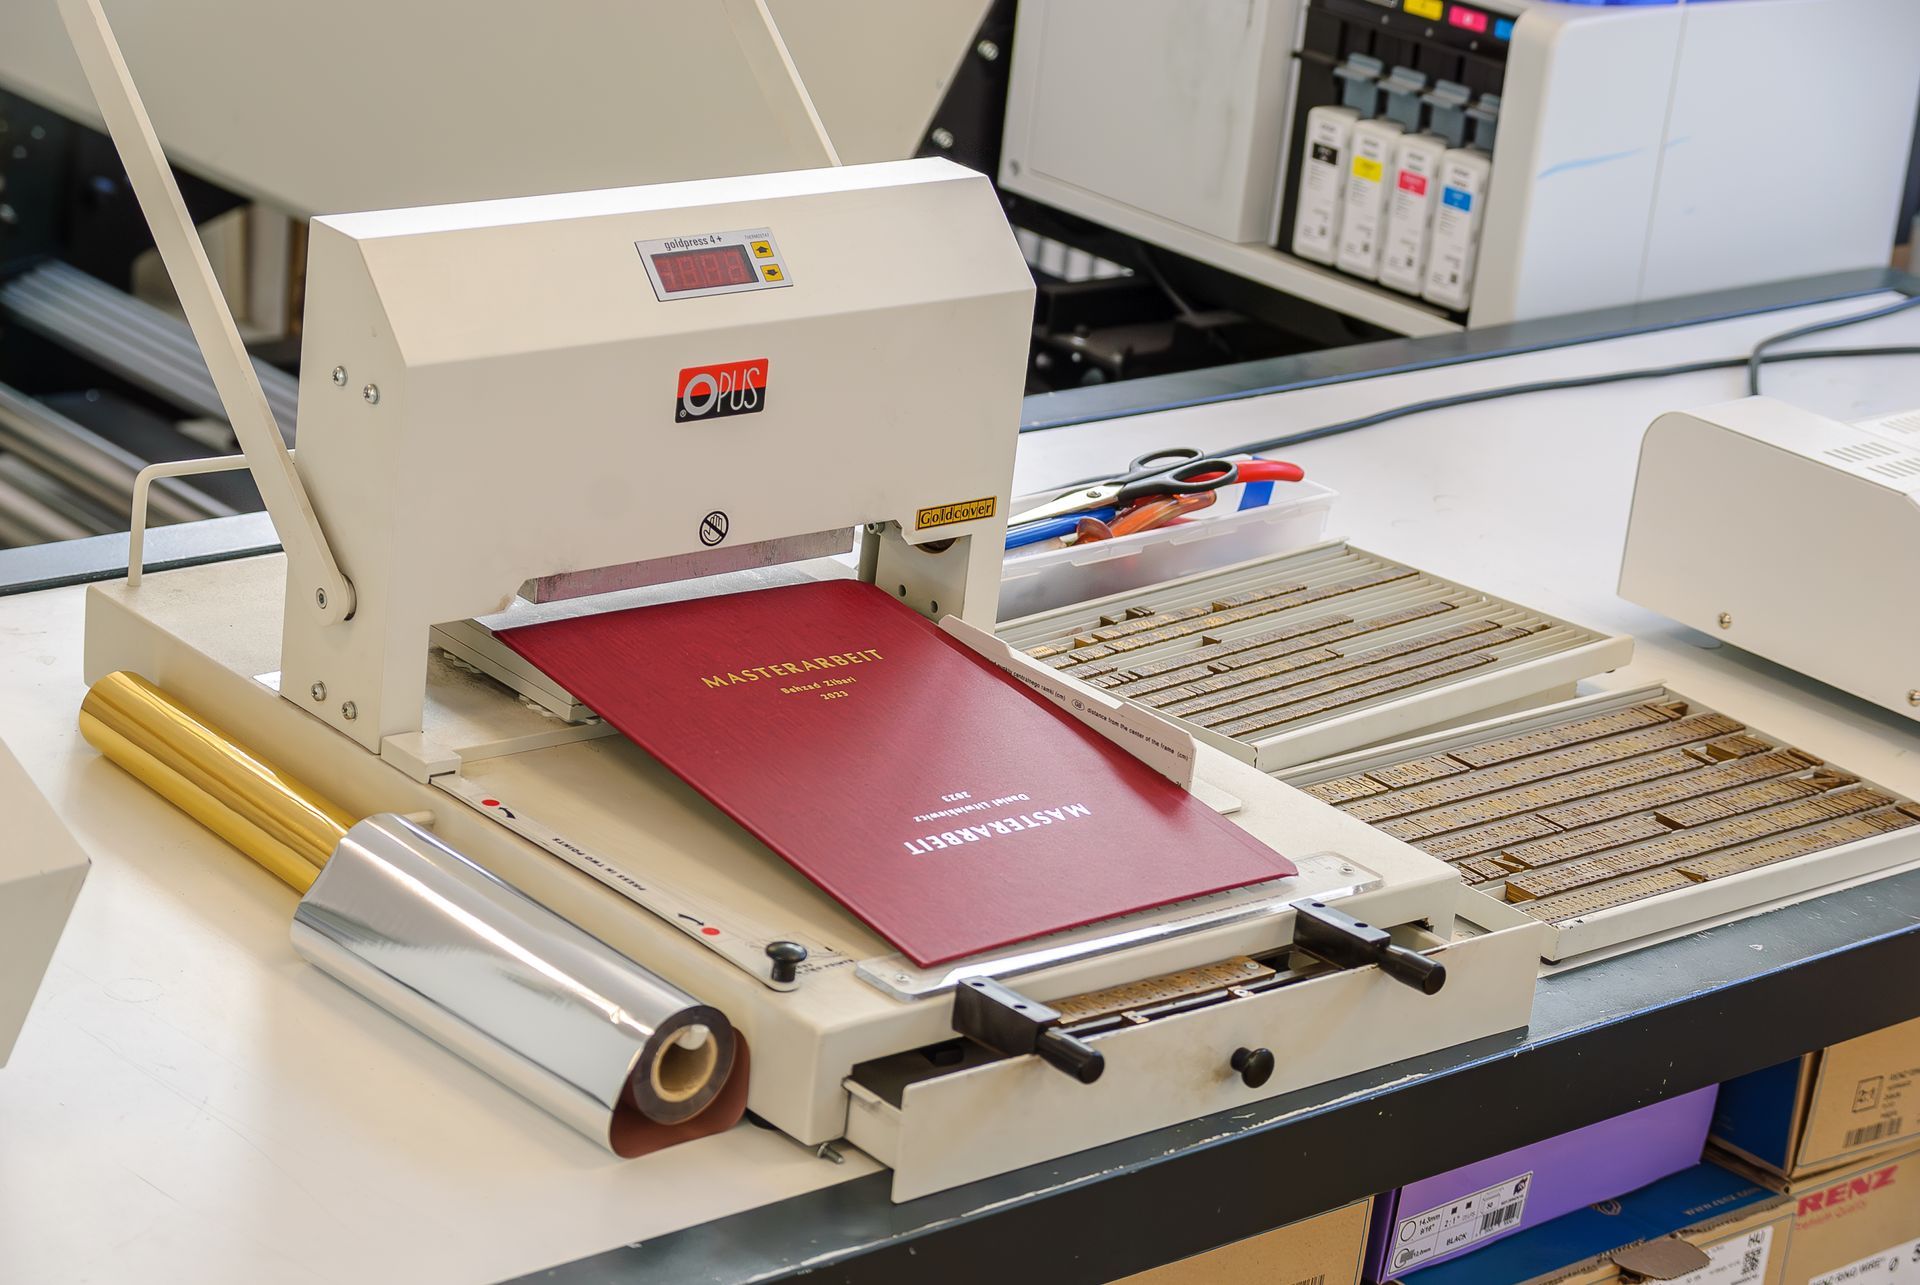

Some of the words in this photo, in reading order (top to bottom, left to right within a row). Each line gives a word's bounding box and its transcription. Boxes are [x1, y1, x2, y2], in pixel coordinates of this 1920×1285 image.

[664, 237, 709, 251] goldpress
[682, 367, 760, 416] OPUS
[921, 503, 992, 525] Goldcover
[701, 648, 885, 689] MASTERARBEIT
[819, 690, 849, 701] 2023
[1086, 707, 1108, 721] distance
[1108, 717, 1120, 727] from
[1120, 723, 1128, 732] the
[1128, 728, 1145, 739] center
[1145, 735, 1151, 743] of
[1151, 738, 1160, 748] the
[1160, 743, 1175, 755] frame
[1176, 750, 1189, 761] (cm)
[941, 790, 972, 803] 2023
[990, 792, 1032, 808] Daniel
[902, 802, 1092, 856] MASTERARBEIT
[551, 836, 586, 857] POINTS
[584, 855, 605, 868] TWO
[616, 873, 648, 892] PRESS
[1796, 1165, 1899, 1218] RENZ
[1446, 1232, 1468, 1247] BLACK
